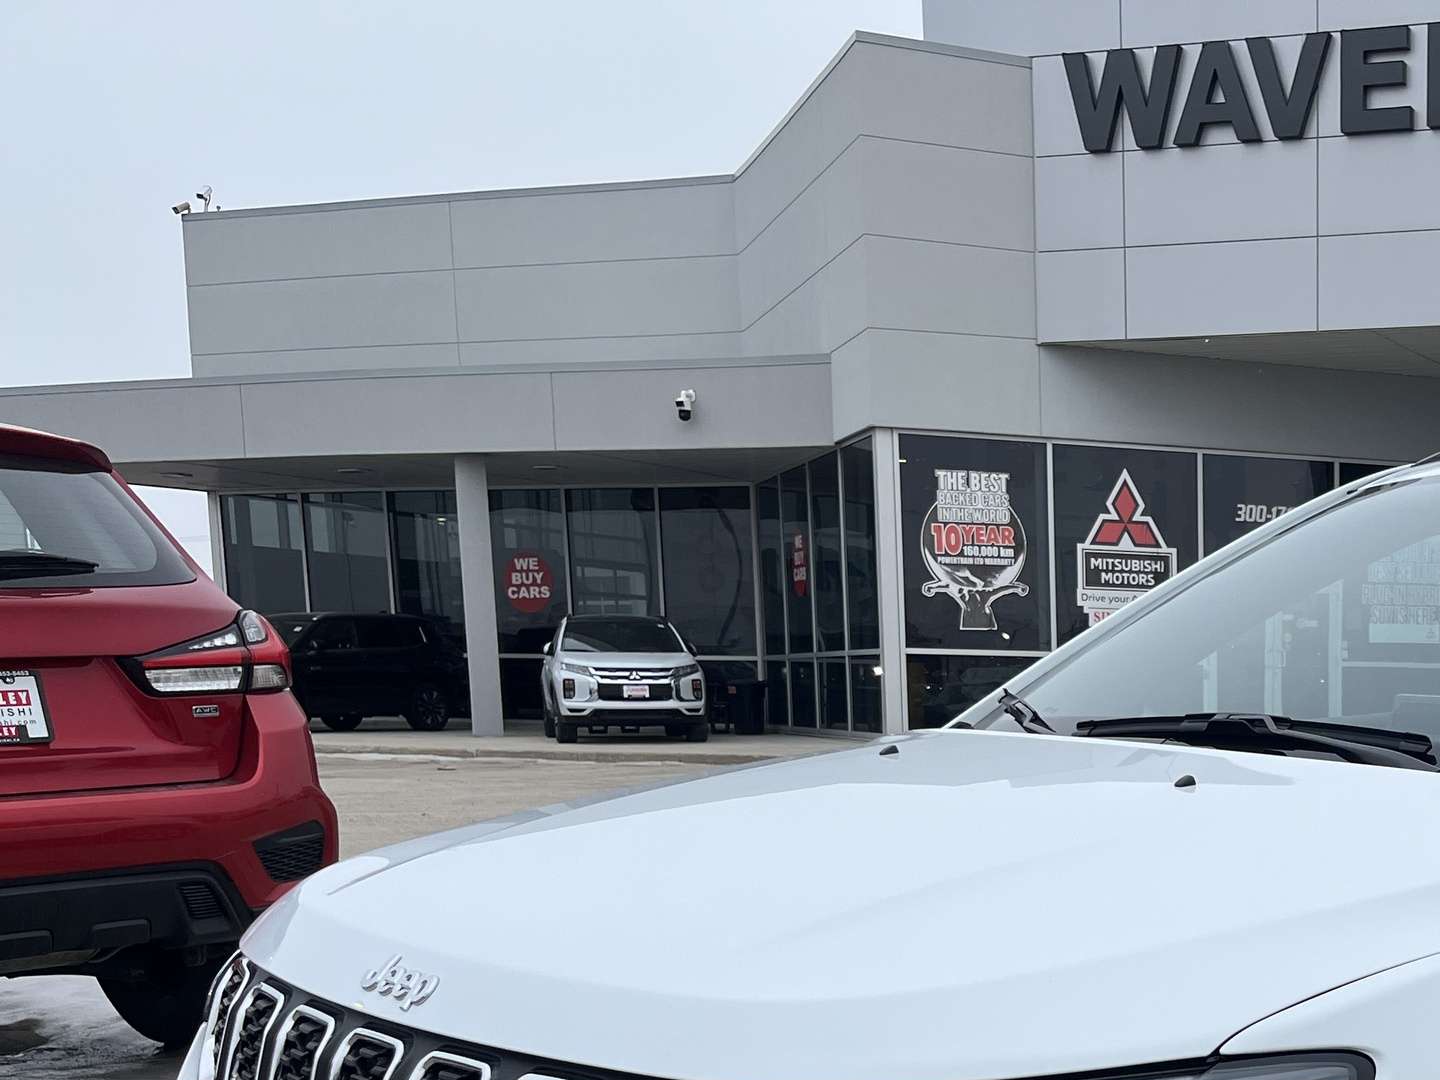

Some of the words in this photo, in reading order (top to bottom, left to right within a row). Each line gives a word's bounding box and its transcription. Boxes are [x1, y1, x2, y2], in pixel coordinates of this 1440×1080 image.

[936, 470, 967, 491] THE
[968, 471, 1009, 492] BEST
[938, 492, 979, 506] BACKED
[981, 494, 1009, 507] CARS
[939, 506, 950, 521] IN
[951, 507, 972, 521] THE
[972, 508, 1010, 523] WORLD
[960, 525, 1015, 546] YEAR
[1000, 546, 1014, 557] km
[514, 557, 539, 570] WE
[1090, 558, 1165, 573] MITSUBISHI
[512, 571, 544, 585] BUY
[1101, 572, 1155, 586] MOTORS
[508, 586, 550, 599] CARS
[1081, 593, 1107, 603] Drive
[1108, 595, 1131, 605] your
[360, 954, 440, 1012] Jeep
